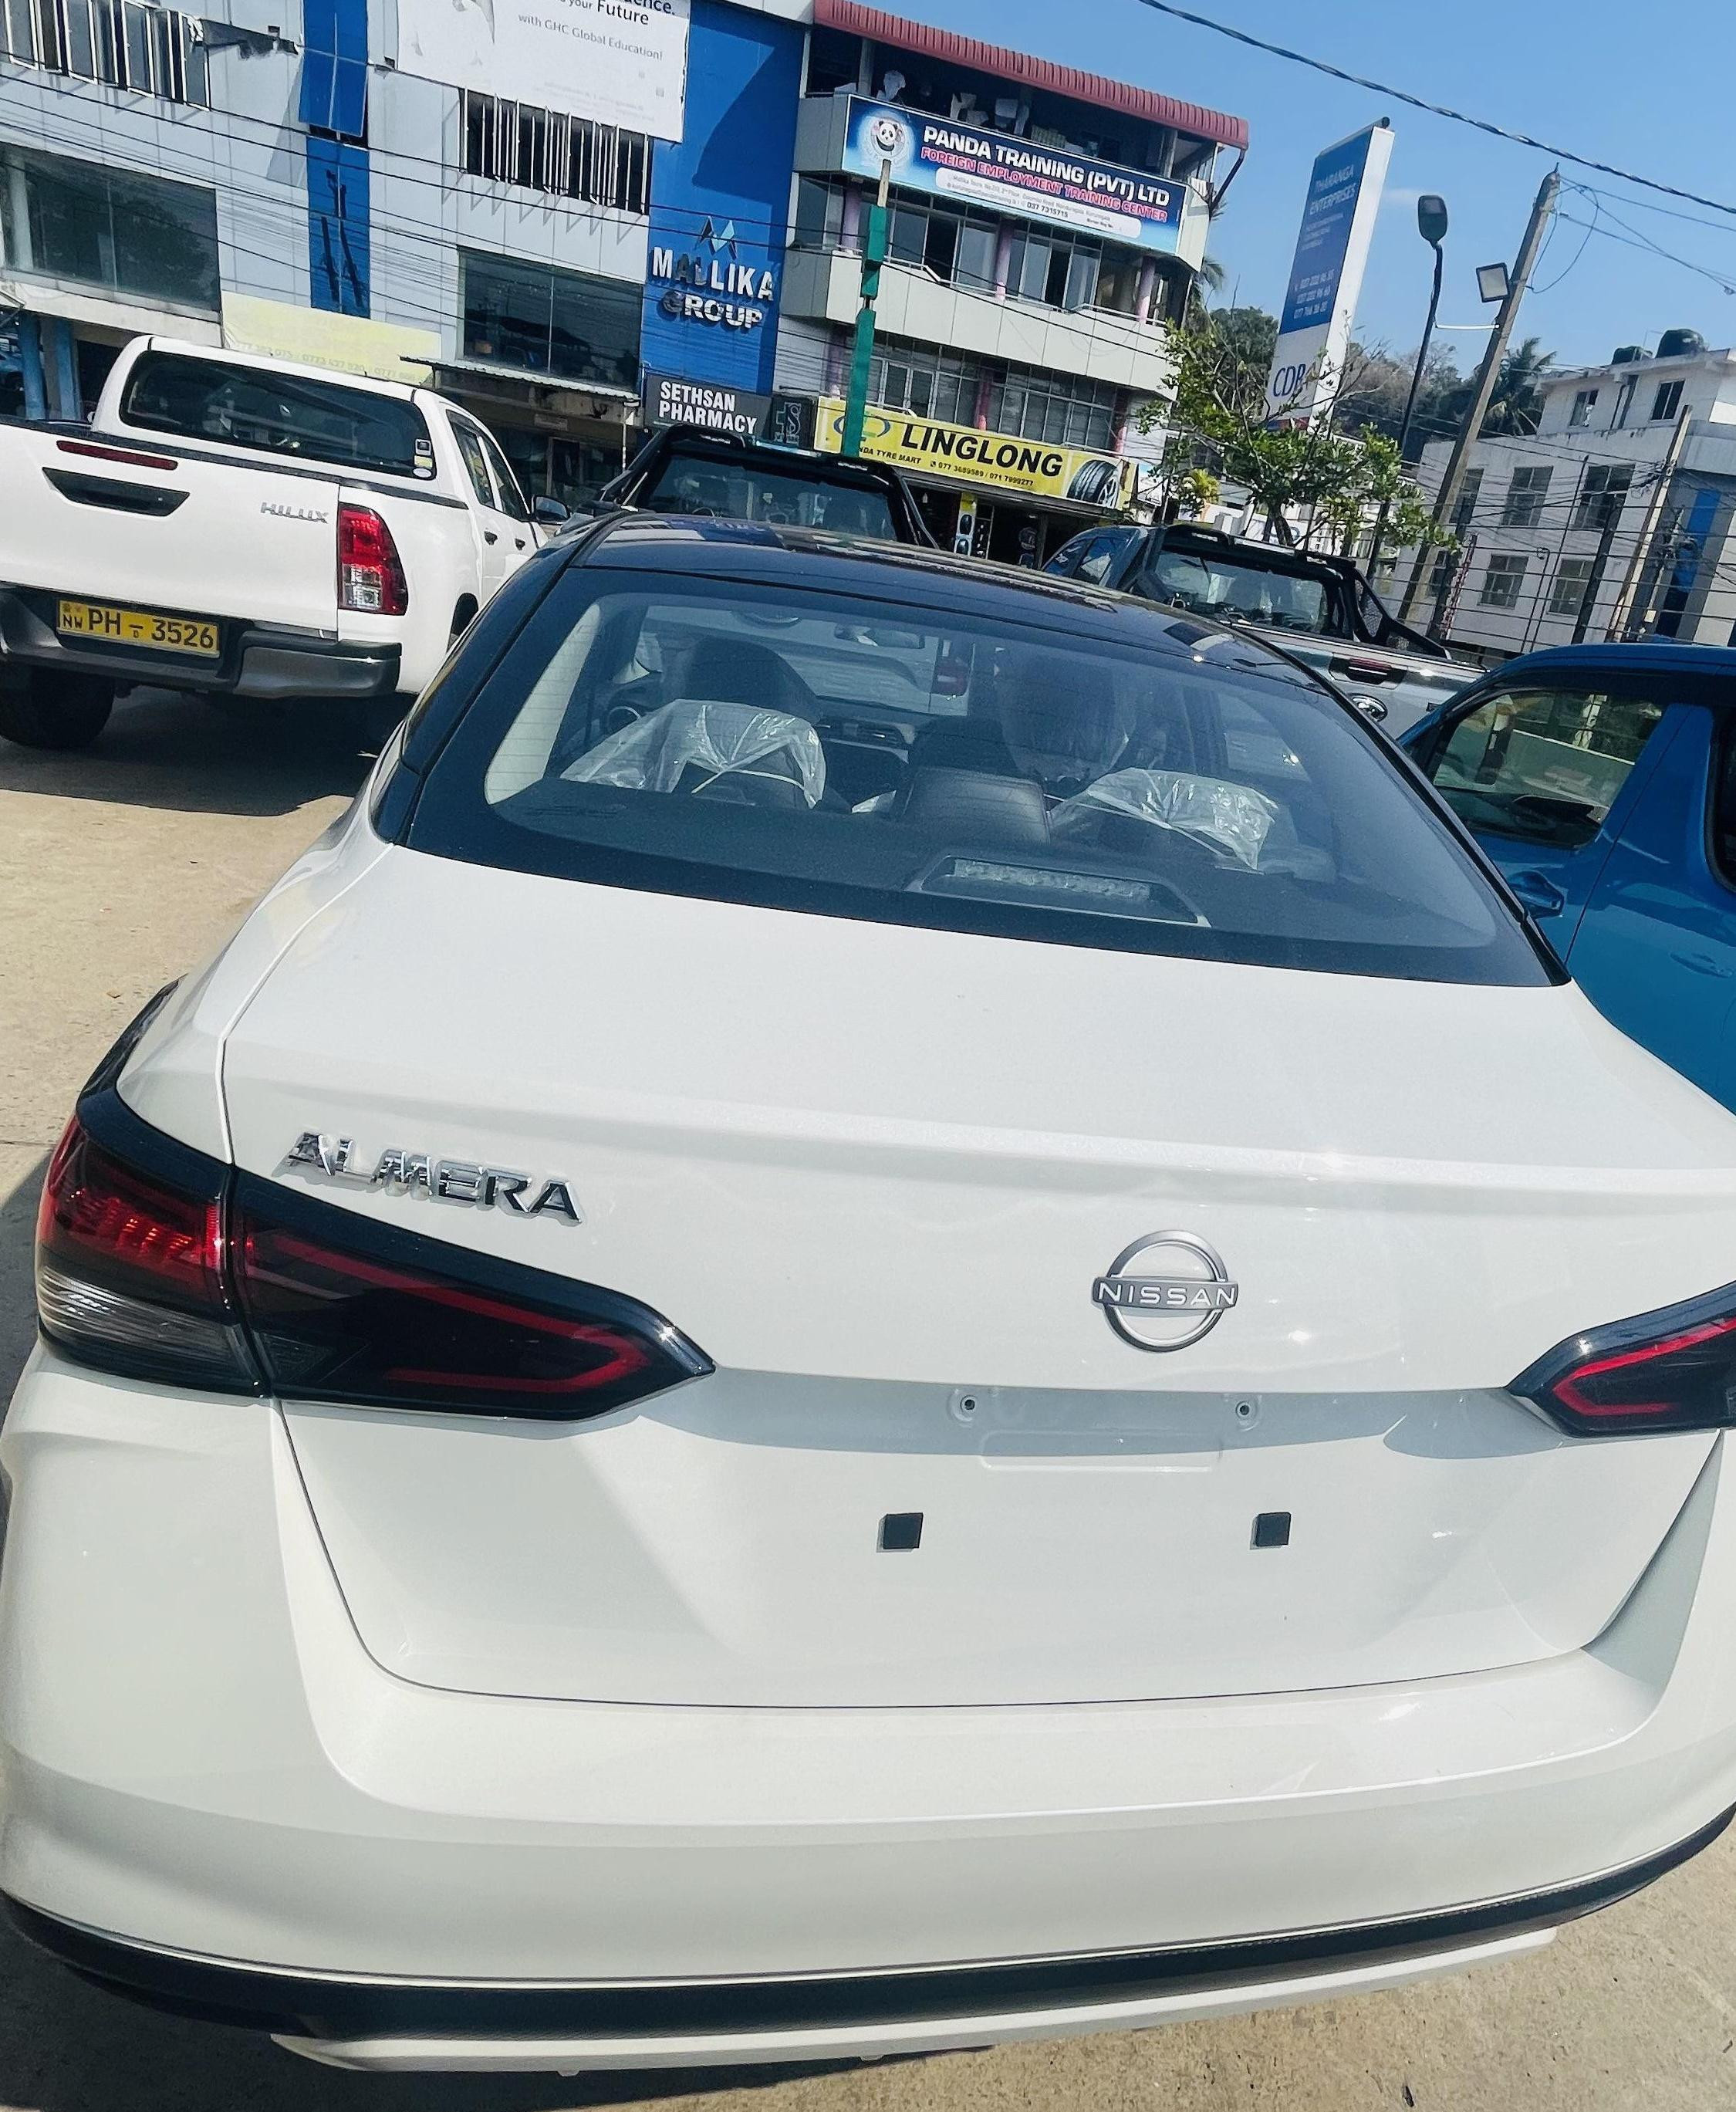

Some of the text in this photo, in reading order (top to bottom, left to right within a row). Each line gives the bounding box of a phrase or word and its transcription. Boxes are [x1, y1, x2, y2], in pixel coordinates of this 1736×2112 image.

[569, 0, 649, 25] your Future
[518, 14, 541, 28] with
[545, 19, 569, 35] GHC
[572, 27, 606, 46] Global
[924, 126, 991, 160] PANDA
[996, 144, 1085, 184] TRAINING
[1086, 171, 1135, 201] (PVT)
[1137, 184, 1170, 207] LTD
[921, 146, 977, 172] FOREIGN
[977, 161, 1064, 194] EMPLOYMENT
[1064, 184, 1121, 211] TRAINING
[1121, 200, 1168, 223] CENTER
[652, 246, 775, 301] MALLIKA
[662, 291, 763, 329] GROUP
[660, 381, 735, 412] SETHSAN
[659, 400, 757, 434] PHARMACY
[876, 449, 897, 460] TYRE
[898, 454, 922, 464] MART
[901, 424, 1063, 478] LINGLONG
[938, 461, 951, 470] 077
[989, 472, 1002, 481] 071
[259, 501, 329, 524] HILUX
[62, 614, 83, 629] NW
[88, 608, 121, 635] PH
[152, 618, 214, 649] 3526
[279, 1131, 583, 1226] ALMERA
[1097, 1282, 1235, 1306] NISSAN
